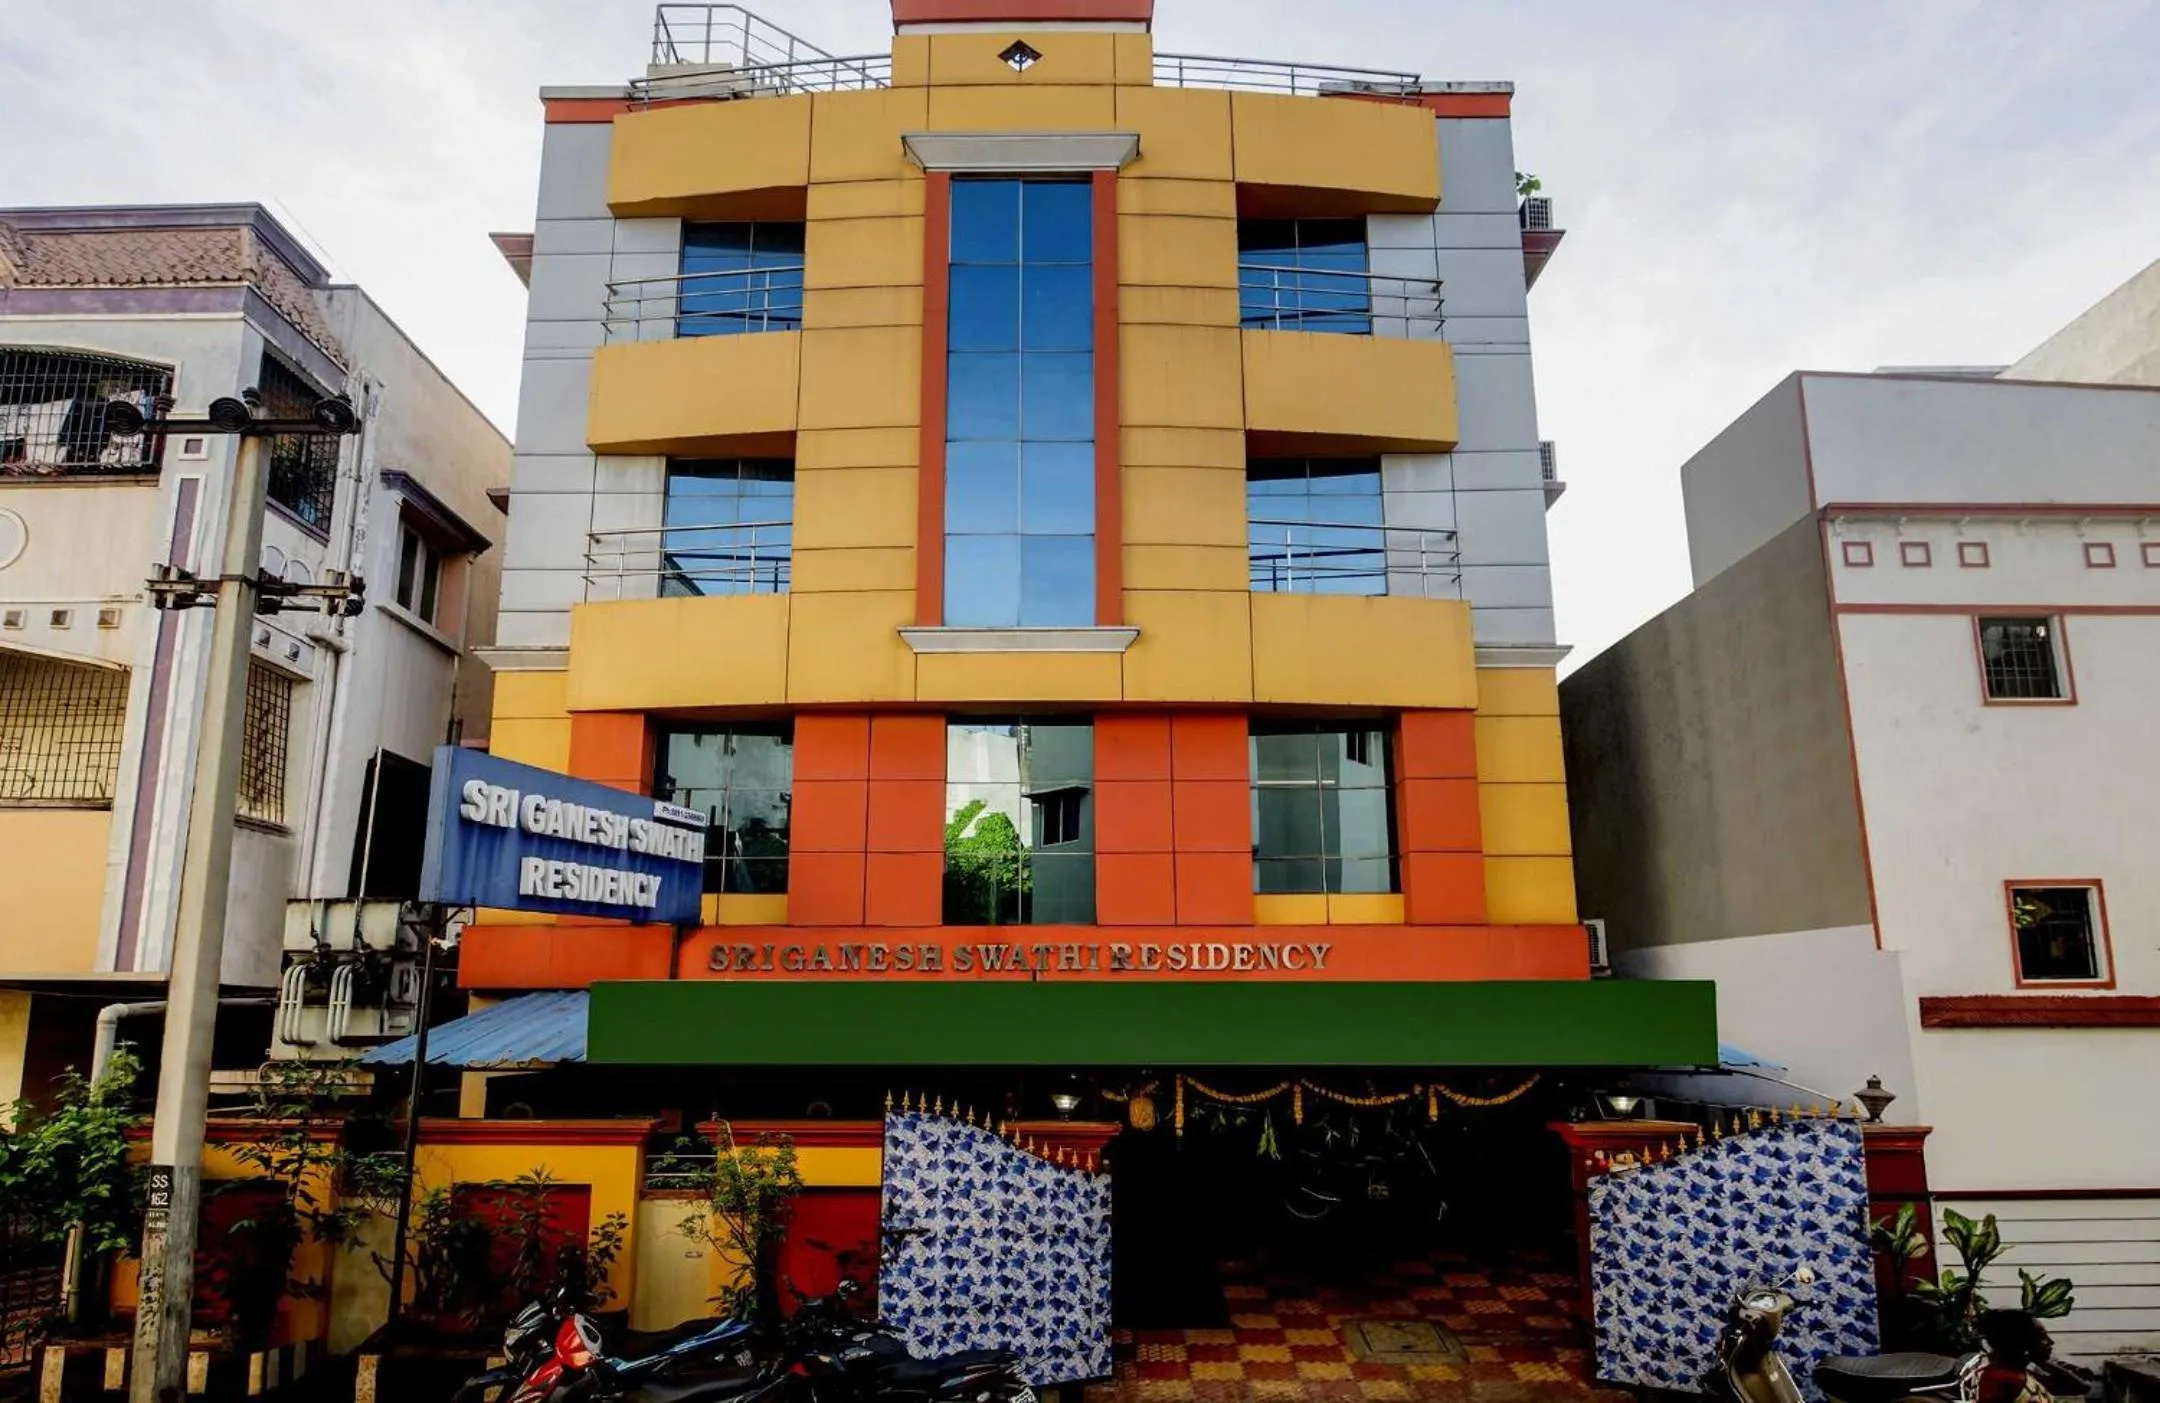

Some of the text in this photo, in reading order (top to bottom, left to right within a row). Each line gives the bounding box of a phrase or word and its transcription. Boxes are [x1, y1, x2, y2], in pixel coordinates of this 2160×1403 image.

[461, 779, 519, 828] SRI
[520, 794, 629, 849] GANESH
[519, 856, 662, 908] RESIDENCY
[709, 943, 1333, 972] SRI GANESH SWATHI RESIDENCY
[151, 1174, 168, 1188] SS
